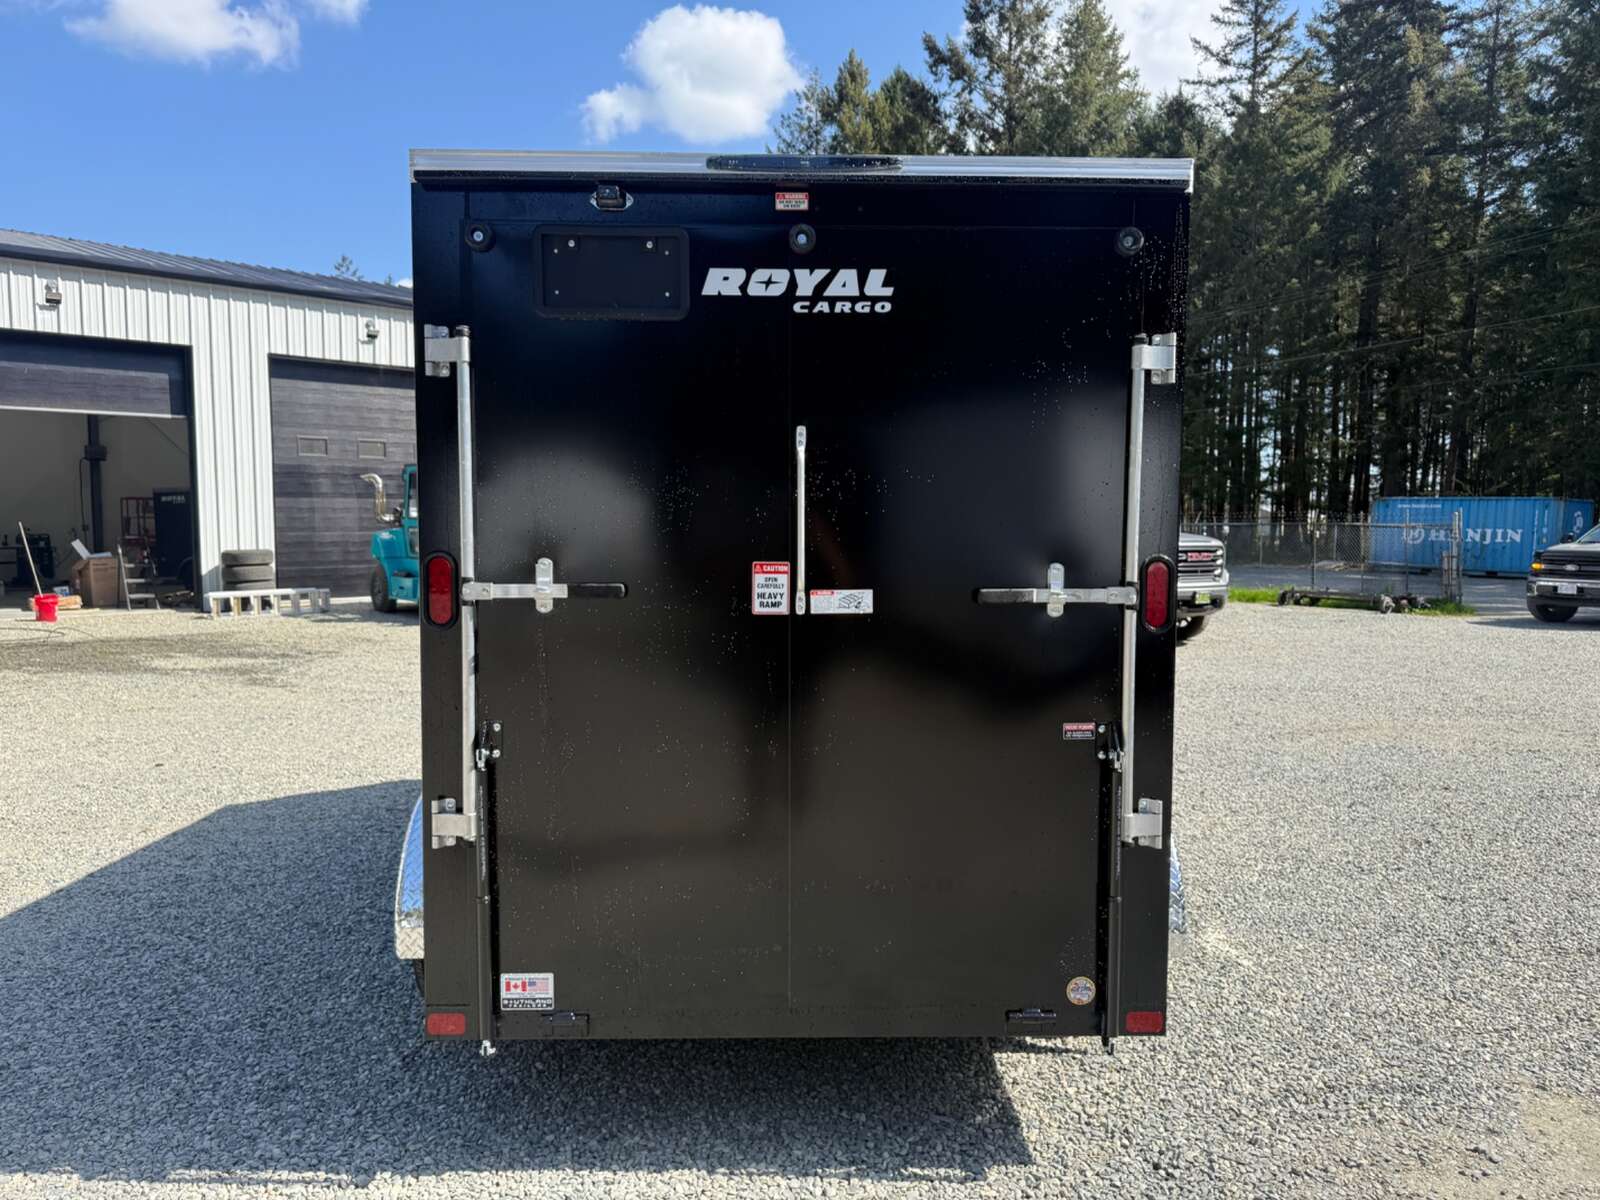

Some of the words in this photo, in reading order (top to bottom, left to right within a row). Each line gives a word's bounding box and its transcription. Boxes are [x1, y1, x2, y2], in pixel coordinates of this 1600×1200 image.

[701, 268, 894, 296] ROYAL
[793, 301, 892, 313] CARGO
[757, 592, 784, 600] HEAVY
